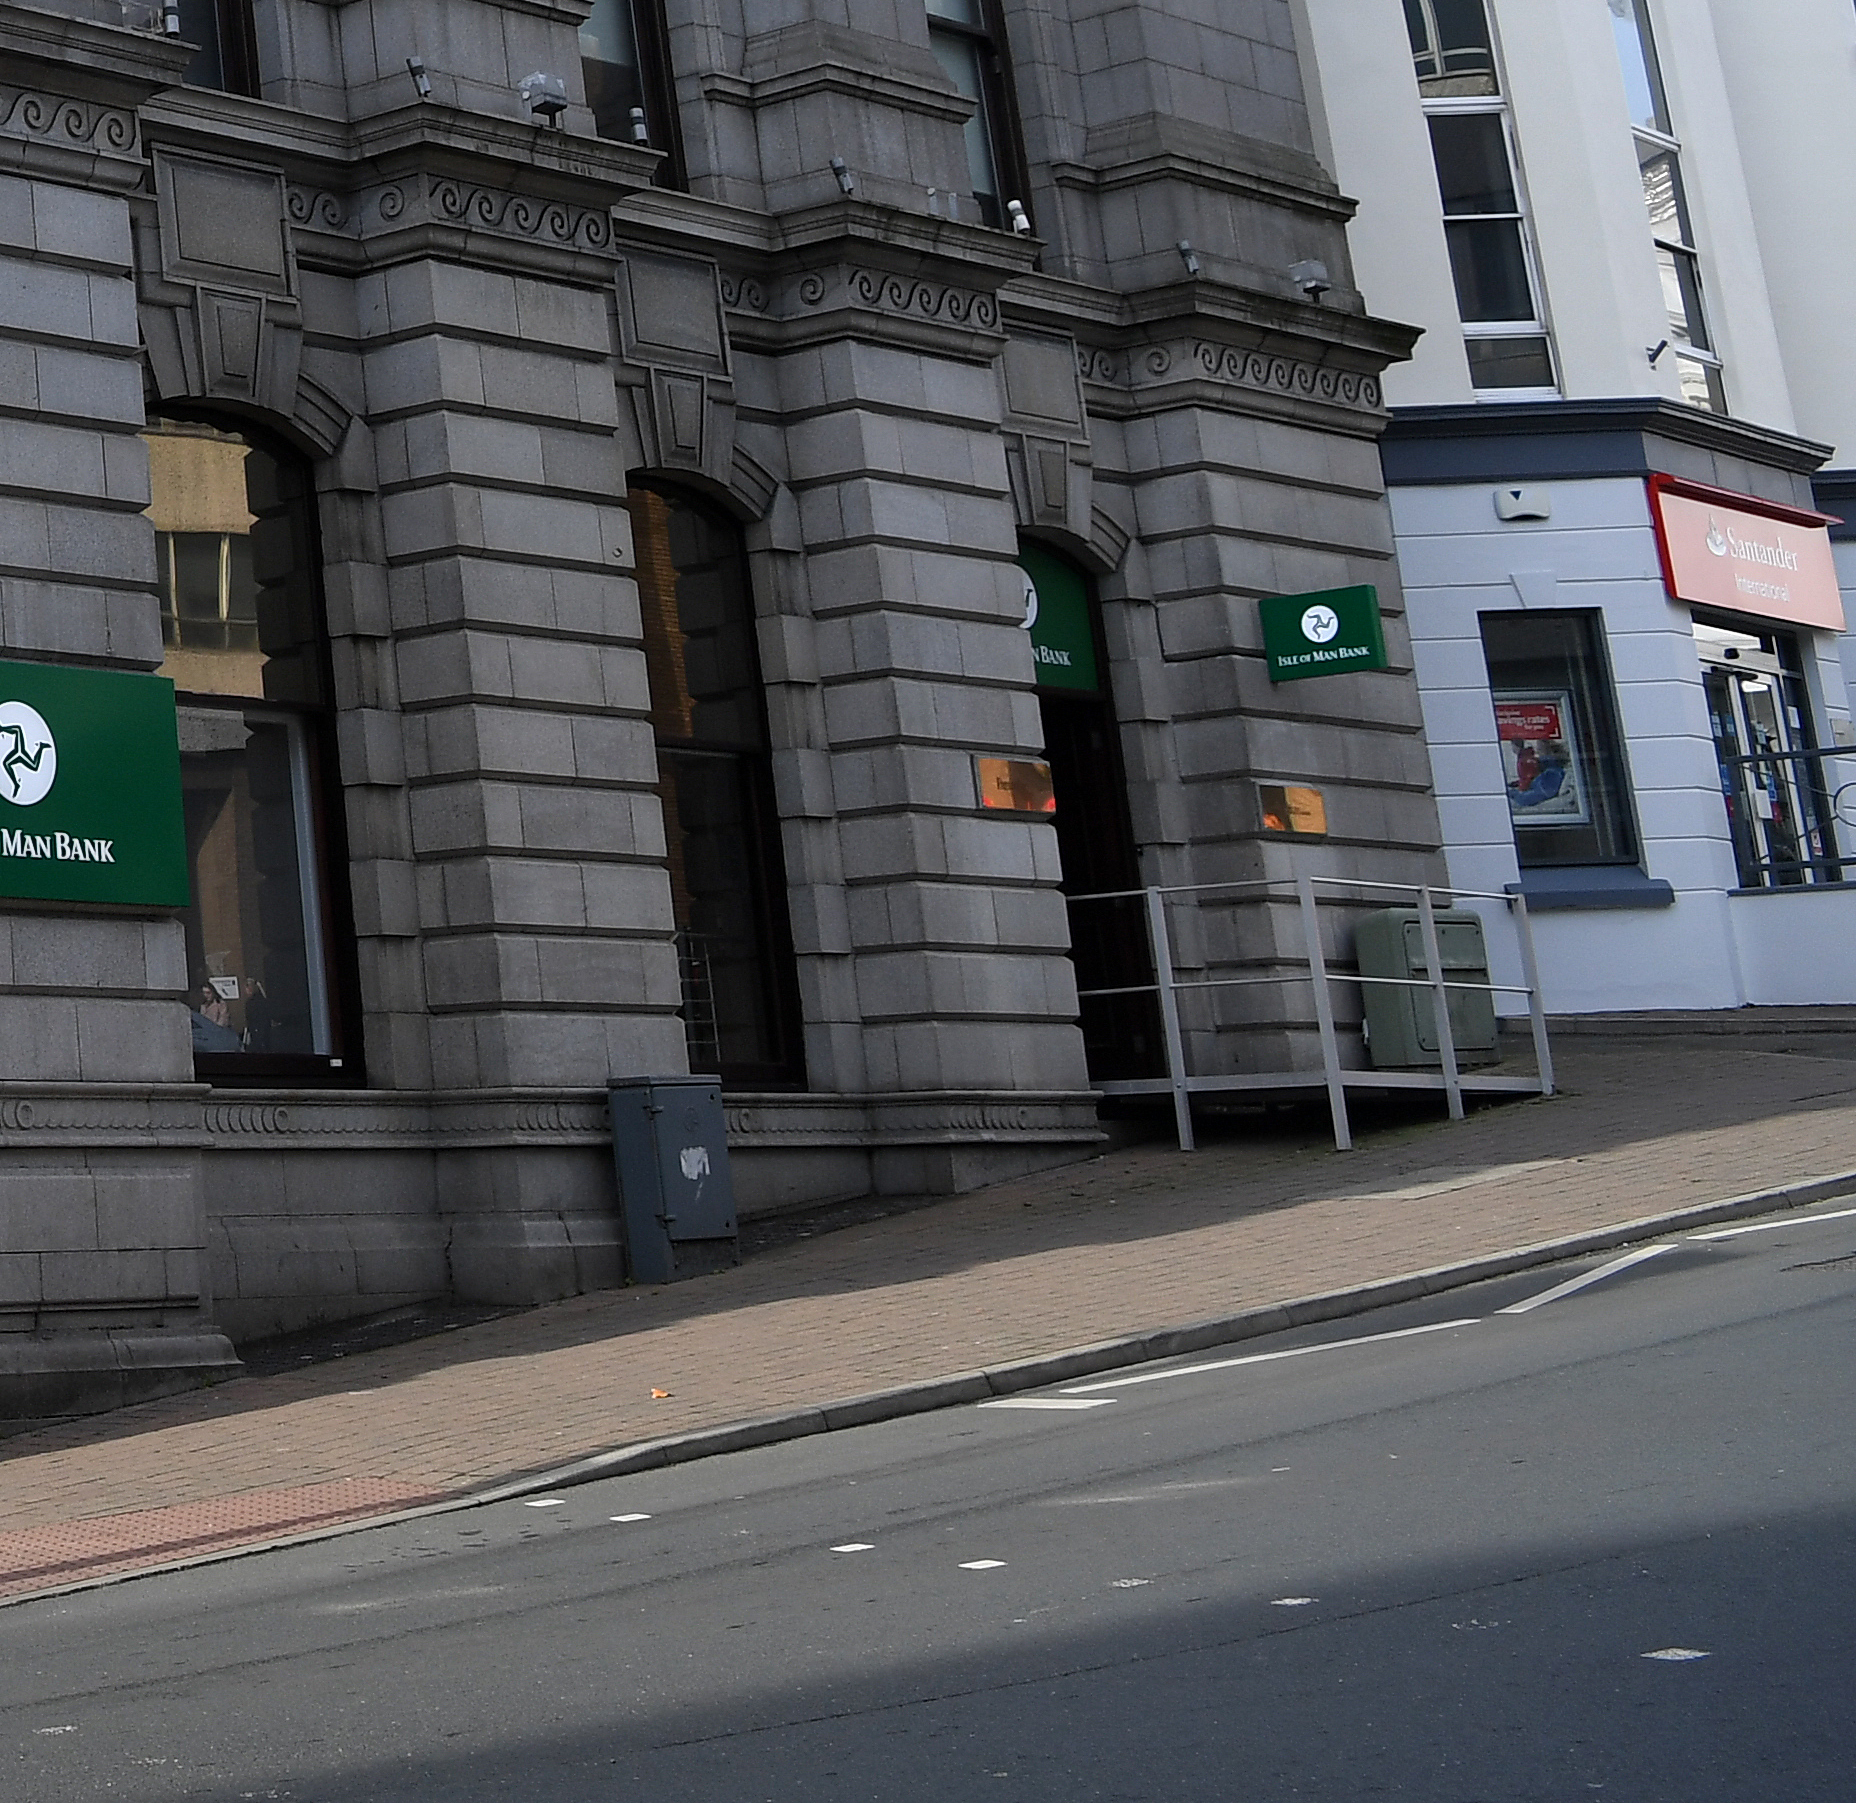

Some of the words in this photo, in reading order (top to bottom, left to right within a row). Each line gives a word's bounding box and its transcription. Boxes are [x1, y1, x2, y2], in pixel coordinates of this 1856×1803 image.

[1726, 527, 1798, 571] Santander
[1734, 573, 1790, 602] International
[1039, 645, 1072, 666] BANK
[1277, 655, 1299, 667] ISLE
[1299, 653, 1311, 663] OF
[1312, 650, 1338, 662] MAN
[1338, 646, 1370, 658] BANK
[0, 828, 51, 859] MAN
[54, 832, 116, 863] BANK
